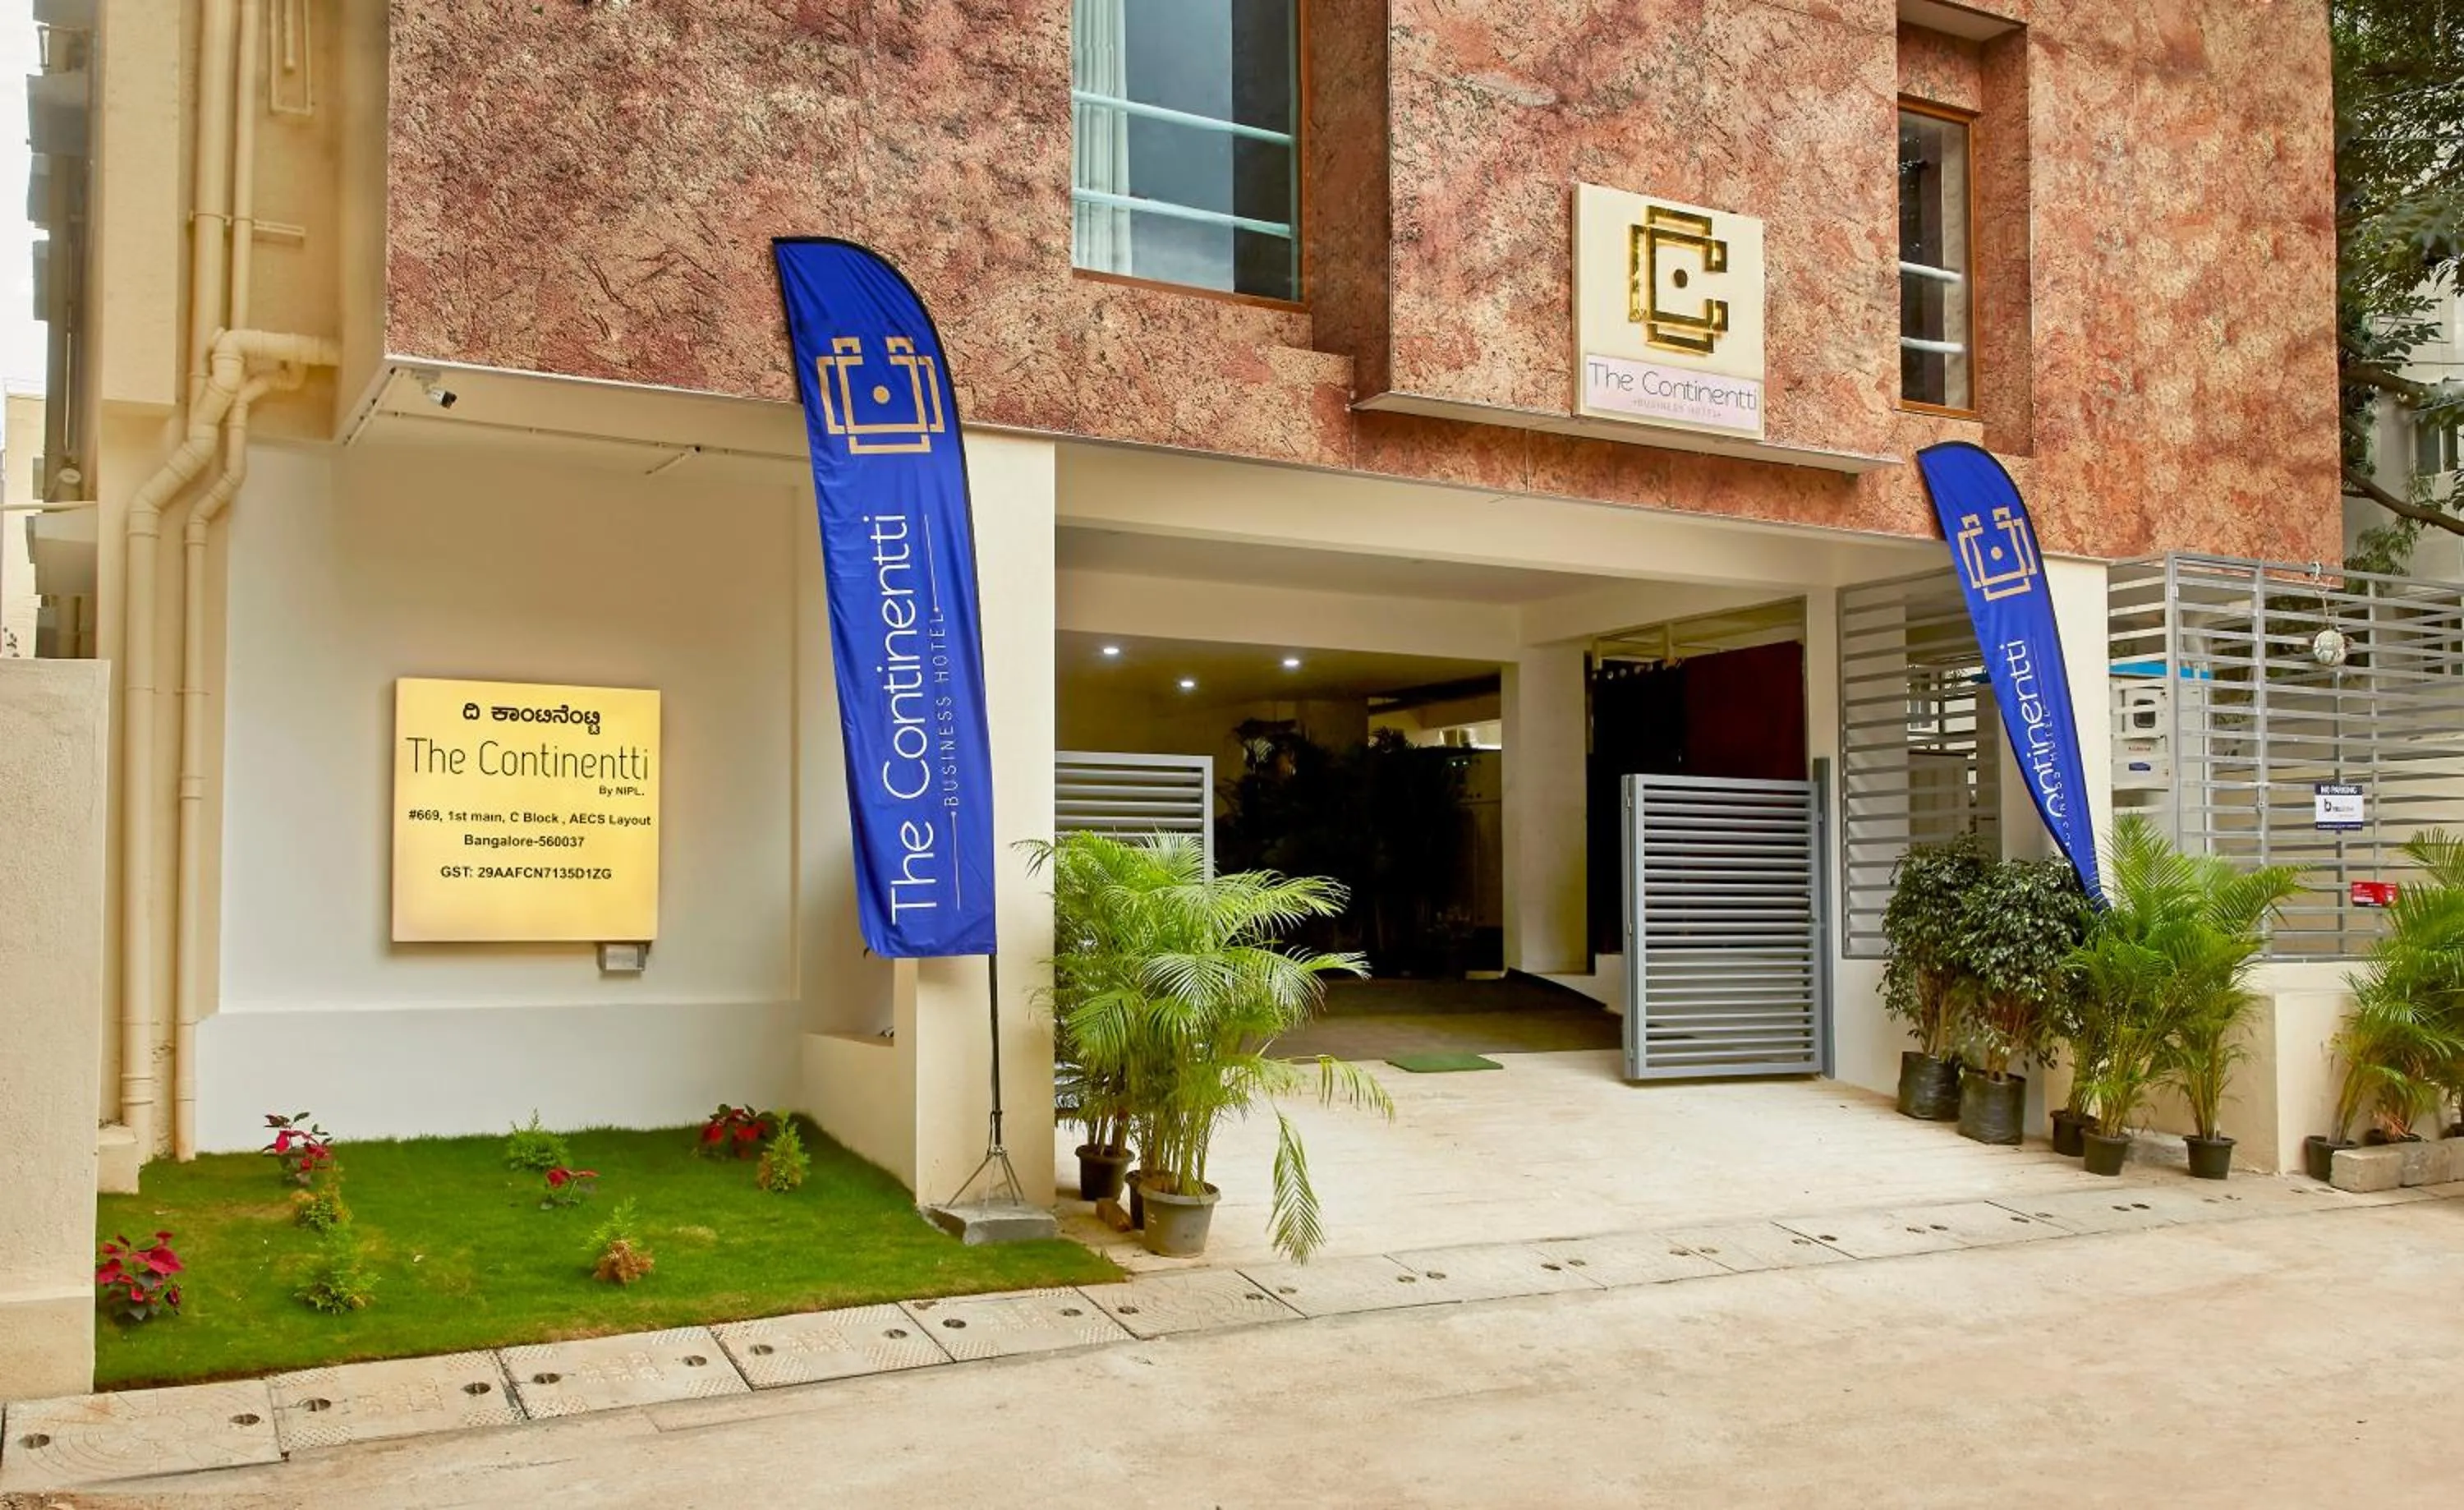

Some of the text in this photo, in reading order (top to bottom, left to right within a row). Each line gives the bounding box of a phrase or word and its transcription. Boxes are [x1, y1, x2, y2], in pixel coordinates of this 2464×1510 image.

[1588, 362, 1757, 410] The Continentti
[462, 702, 480, 720] ದಿ
[930, 614, 960, 807] BUSINESS HOTEL
[863, 515, 937, 925] The Continentti
[406, 737, 648, 780] The Continentti
[599, 785, 645, 797] By NIPL.
[408, 809, 443, 822] #669,
[448, 811, 467, 822] 1st
[471, 812, 505, 823] main,
[510, 812, 519, 822] C
[569, 813, 605, 824] AECS
[609, 814, 651, 826] Layout
[464, 834, 585, 848] Bangalore-560037
[440, 866, 612, 879] GST: 29AAFCN7135D1ZG
